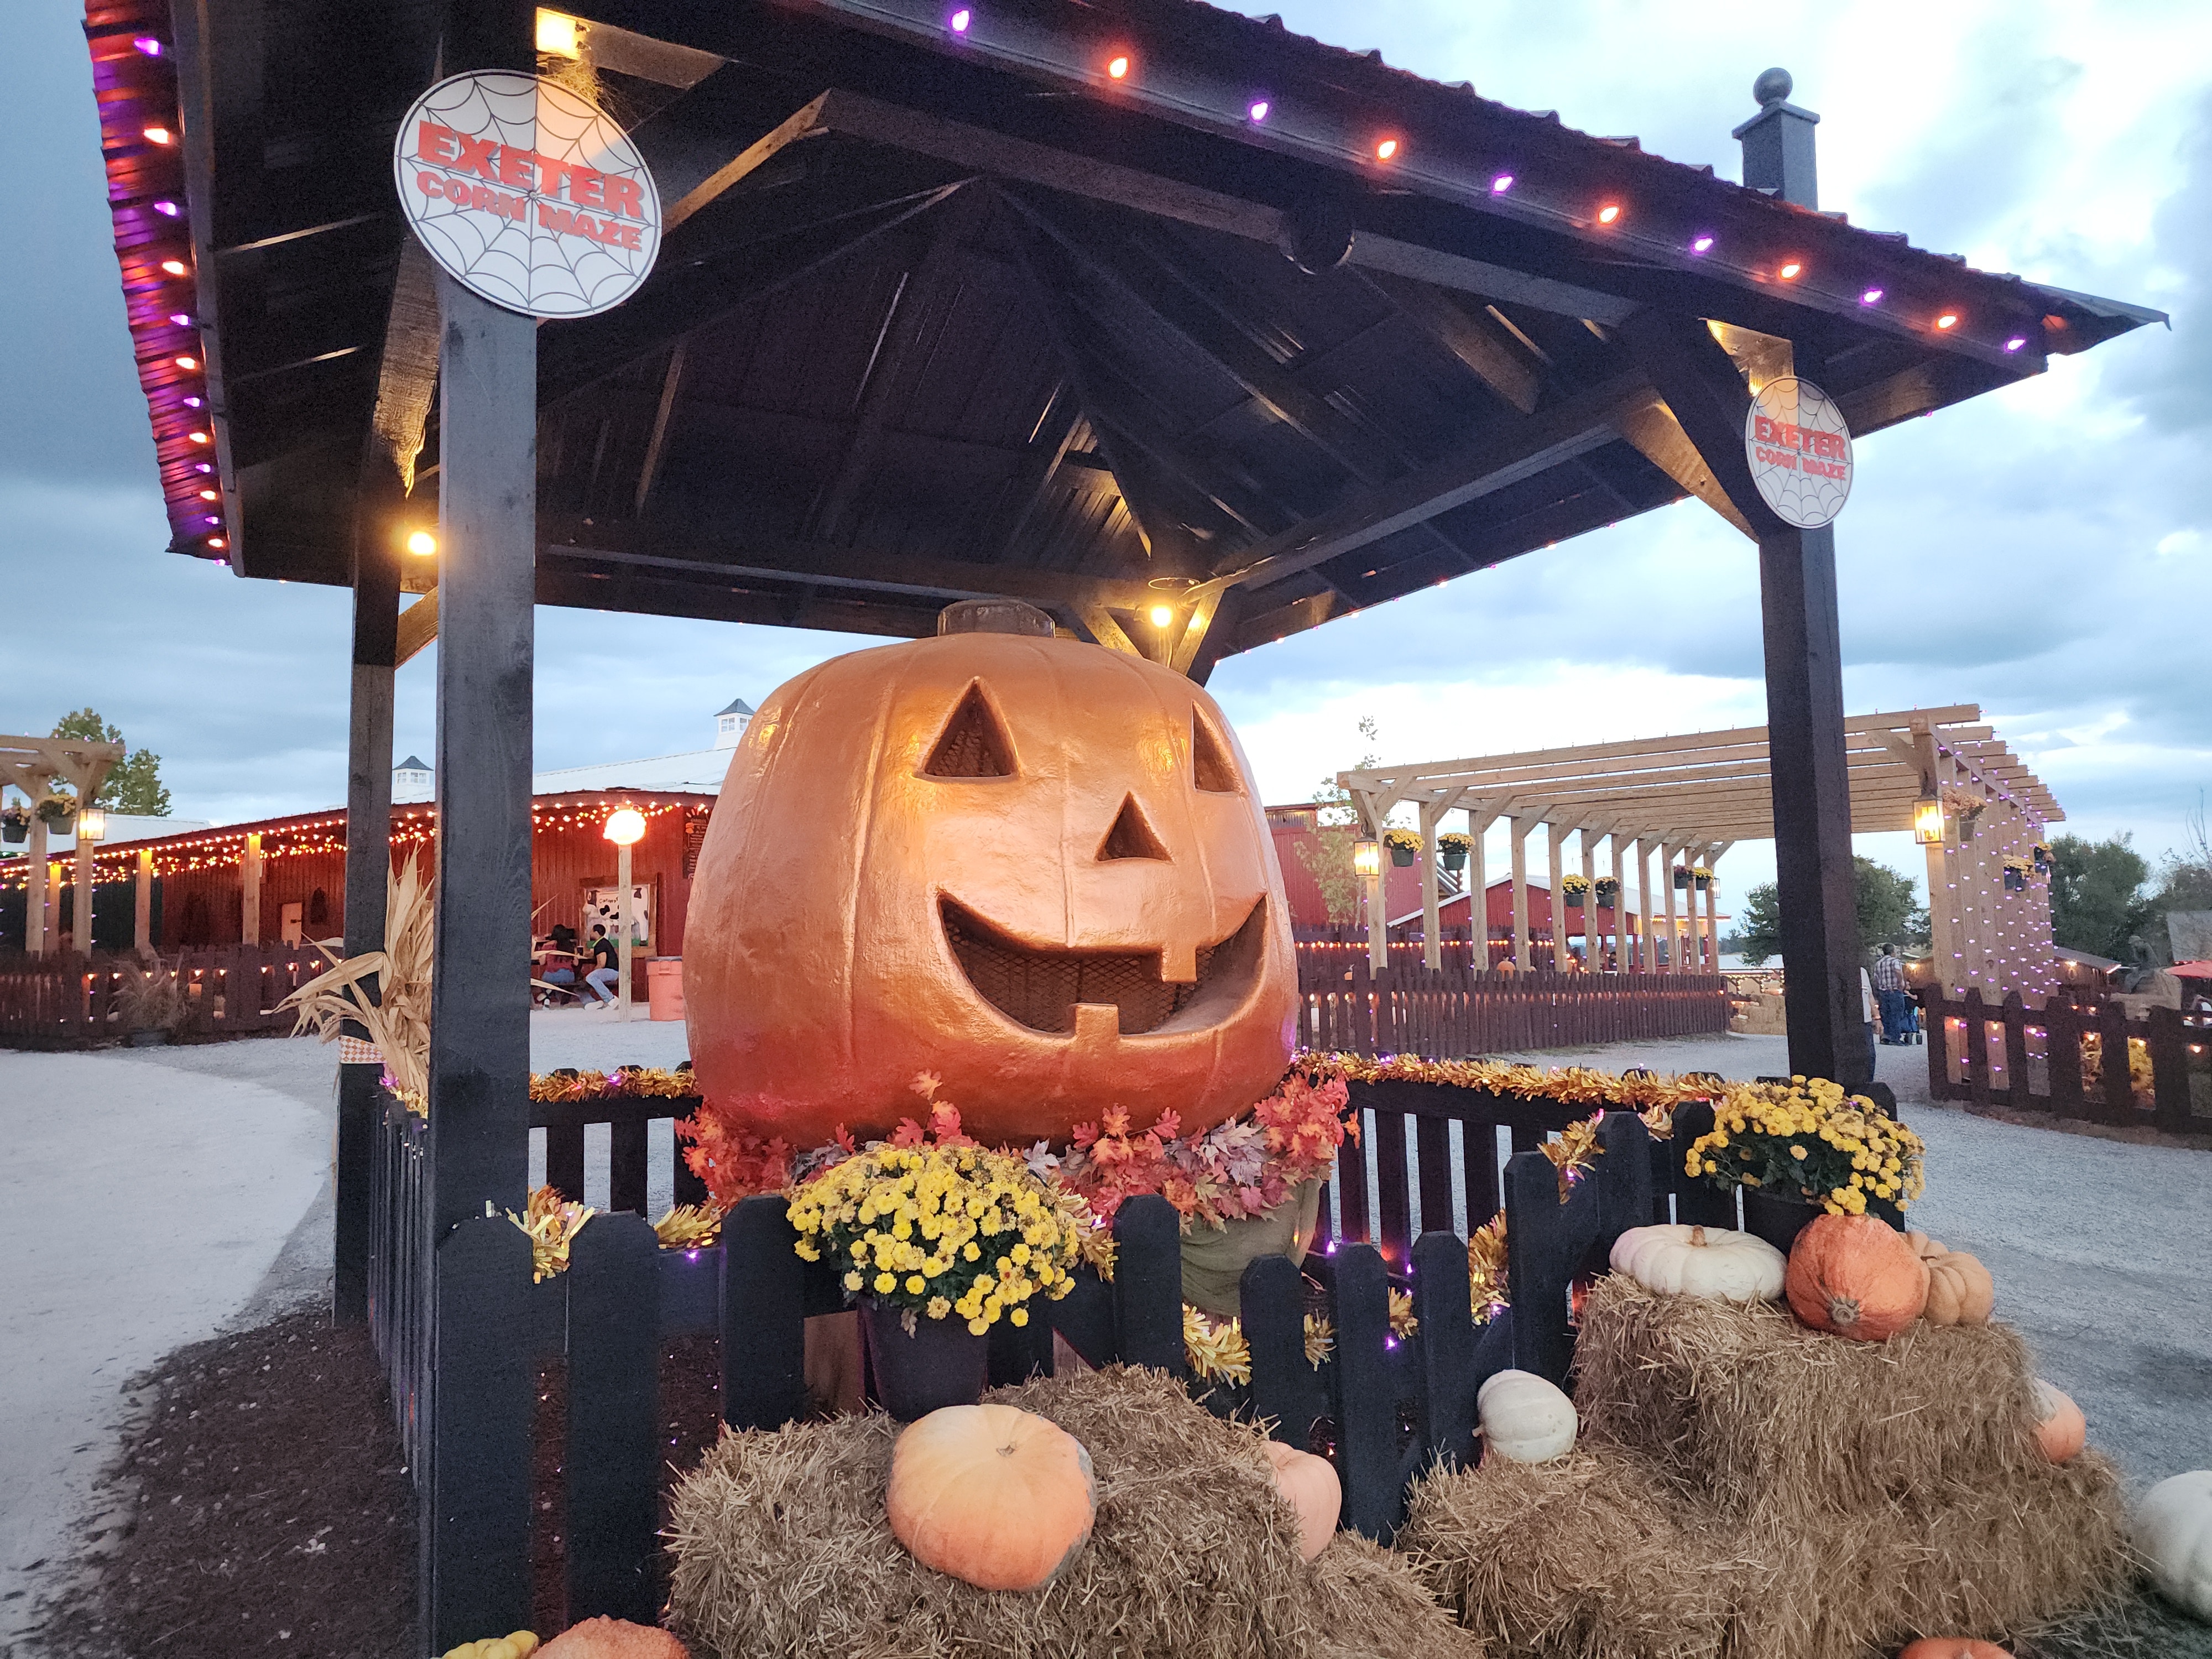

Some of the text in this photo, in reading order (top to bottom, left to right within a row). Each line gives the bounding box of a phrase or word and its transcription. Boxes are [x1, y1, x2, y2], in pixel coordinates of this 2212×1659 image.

[418, 119, 643, 218] EXETER
[416, 171, 643, 252] CORN MAZE
[1755, 415, 1846, 460] EXETER
[1755, 446, 1846, 481] CORN MAZE
